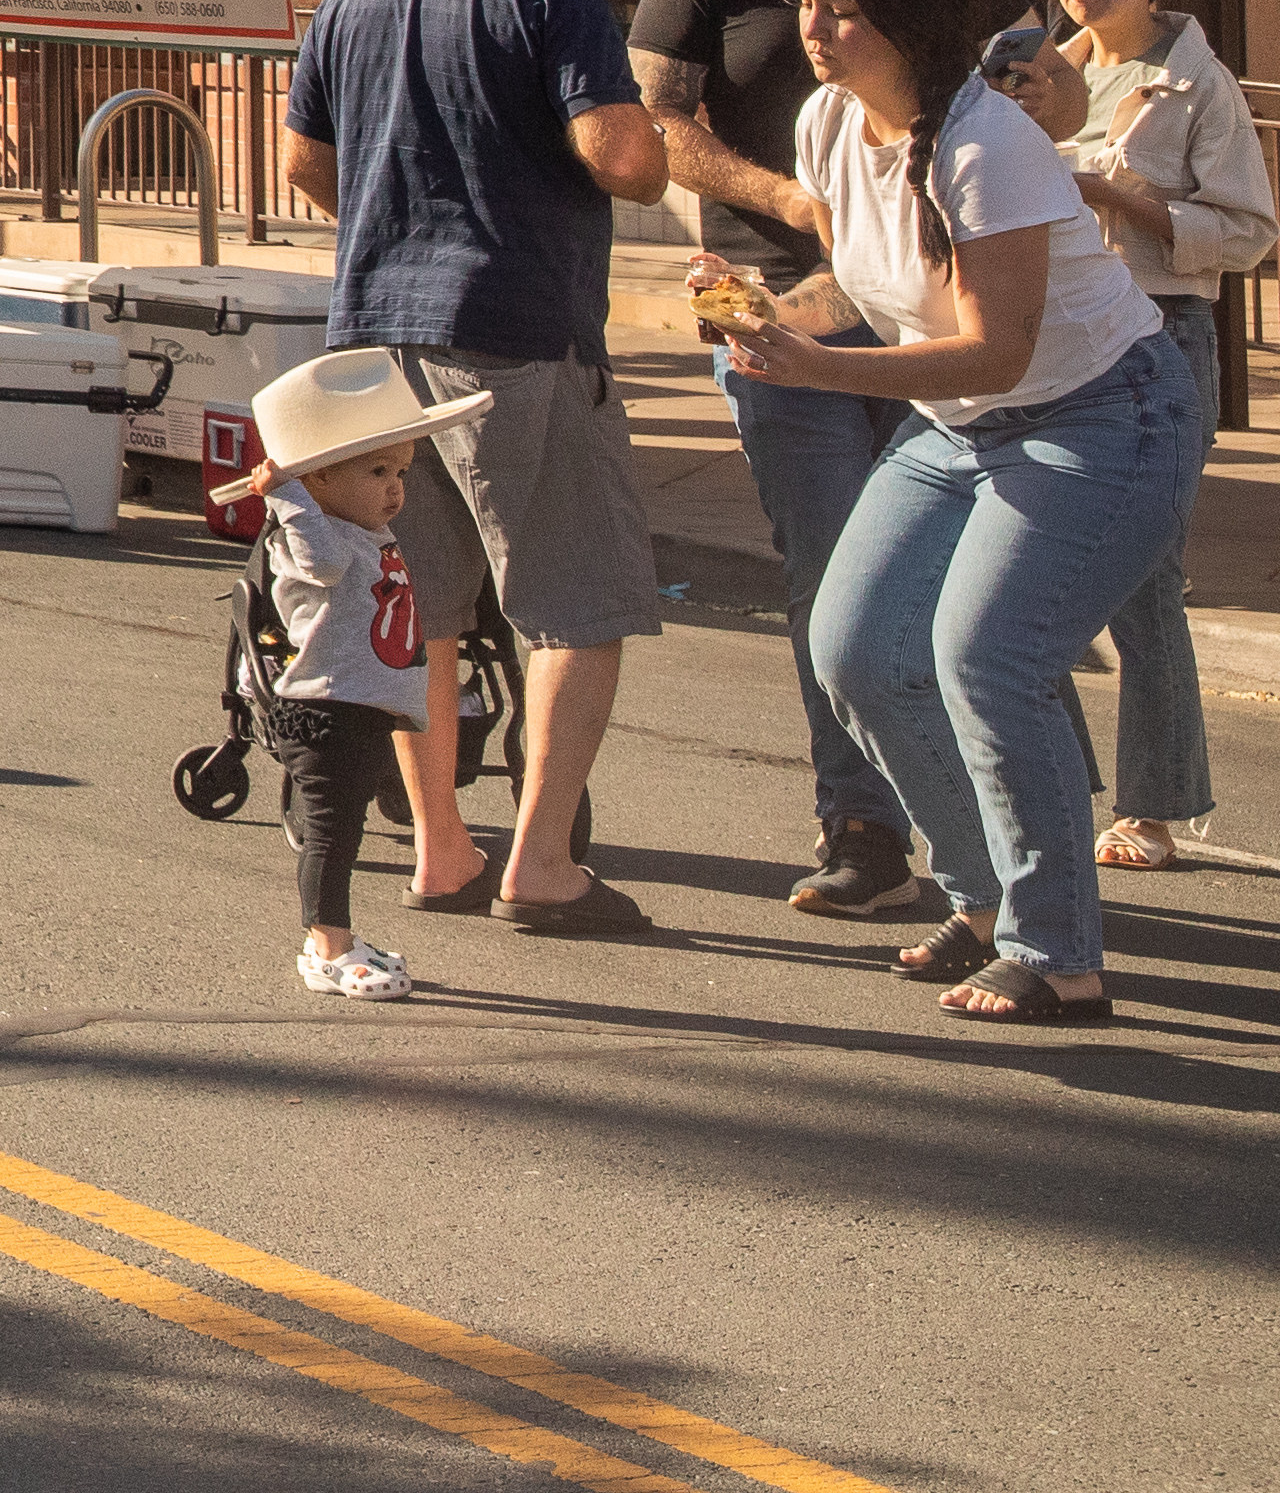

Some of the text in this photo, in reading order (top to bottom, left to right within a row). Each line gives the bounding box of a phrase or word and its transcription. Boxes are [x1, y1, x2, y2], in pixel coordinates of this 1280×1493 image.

[101, 0, 132, 13] 94080
[154, 0, 178, 17] (650)
[179, 1, 225, 18] 588-0600
[129, 431, 167, 450] COOLER
